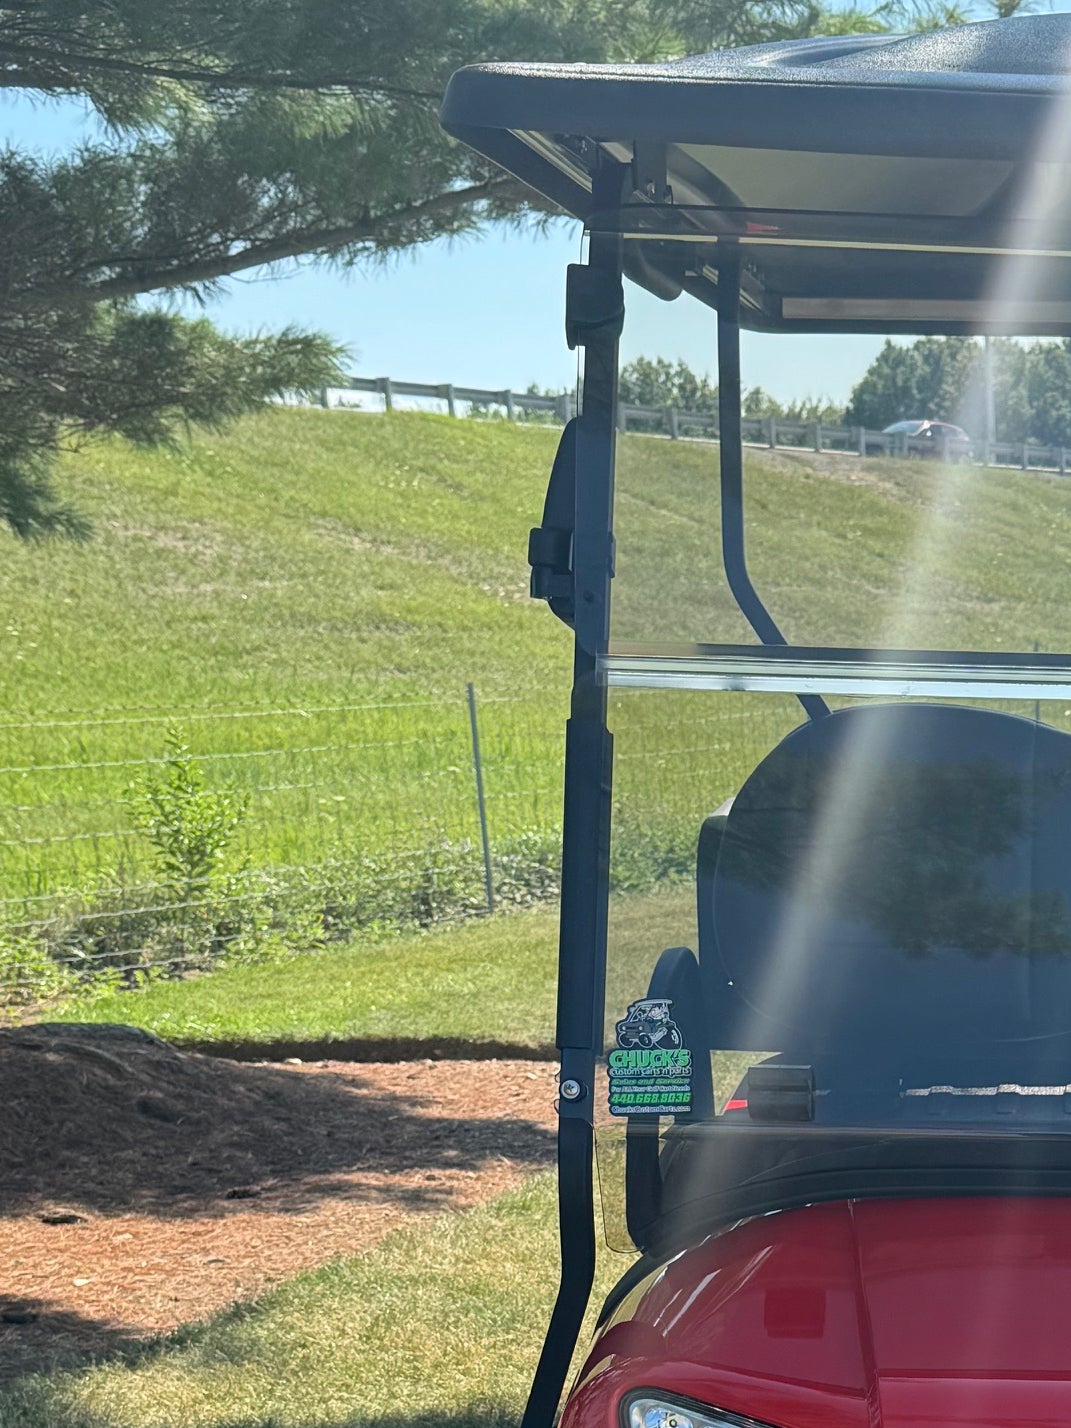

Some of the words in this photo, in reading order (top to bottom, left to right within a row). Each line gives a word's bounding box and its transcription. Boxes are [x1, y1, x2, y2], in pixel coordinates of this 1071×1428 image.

[609, 1050, 691, 1068] CHUCK'S
[611, 1067, 640, 1076] custom
[611, 1092, 691, 1103] 440.668.8036
